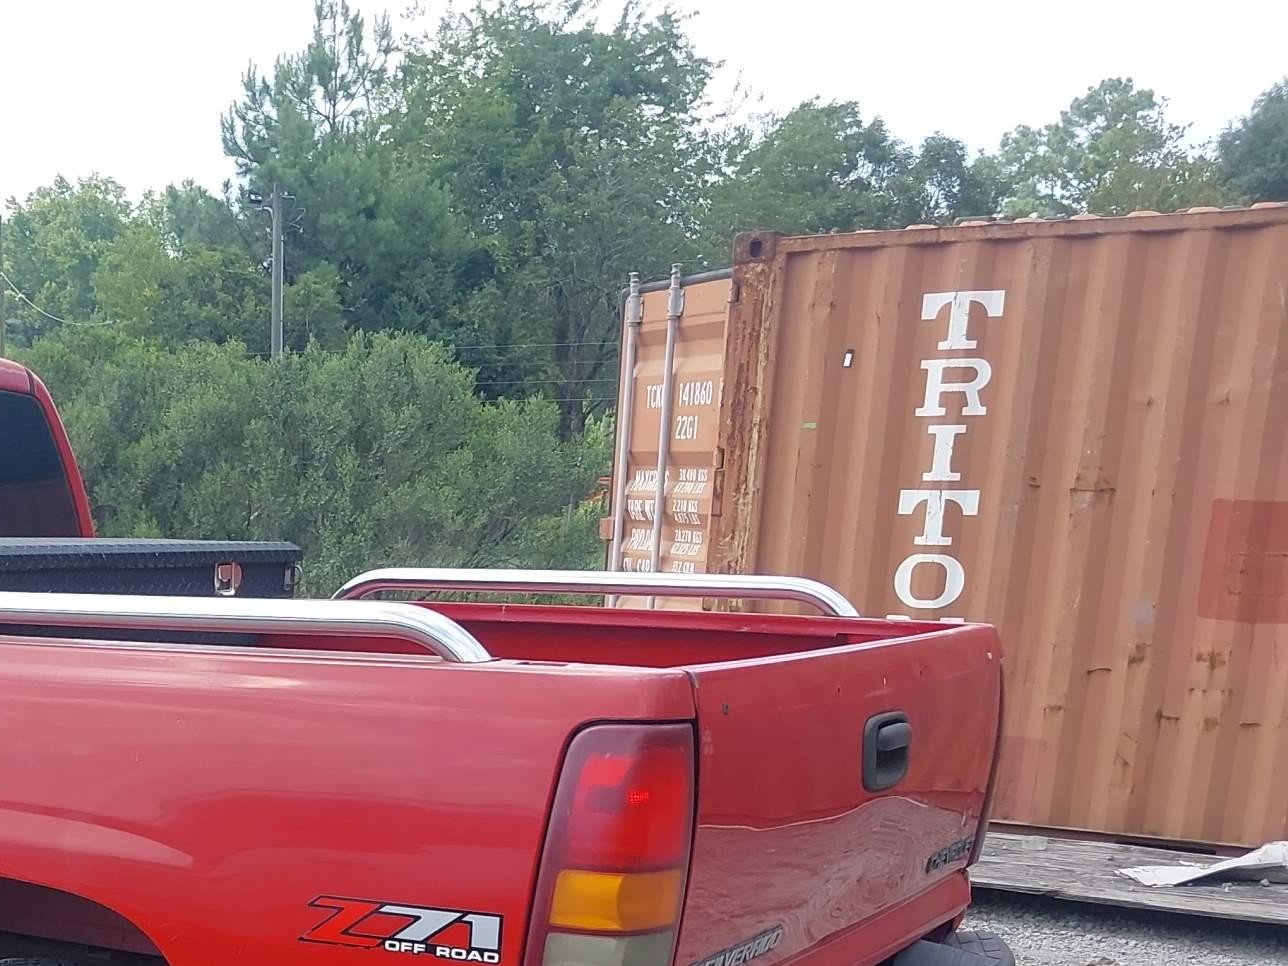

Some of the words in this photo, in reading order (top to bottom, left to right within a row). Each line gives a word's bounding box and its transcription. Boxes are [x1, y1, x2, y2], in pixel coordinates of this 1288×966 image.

[678, 380, 713, 407] 141860
[674, 415, 699, 439] 22G1
[886, 289, 1005, 622] TRITO
[384, 939, 426, 955] OFF
[435, 946, 500, 965] ROAD
